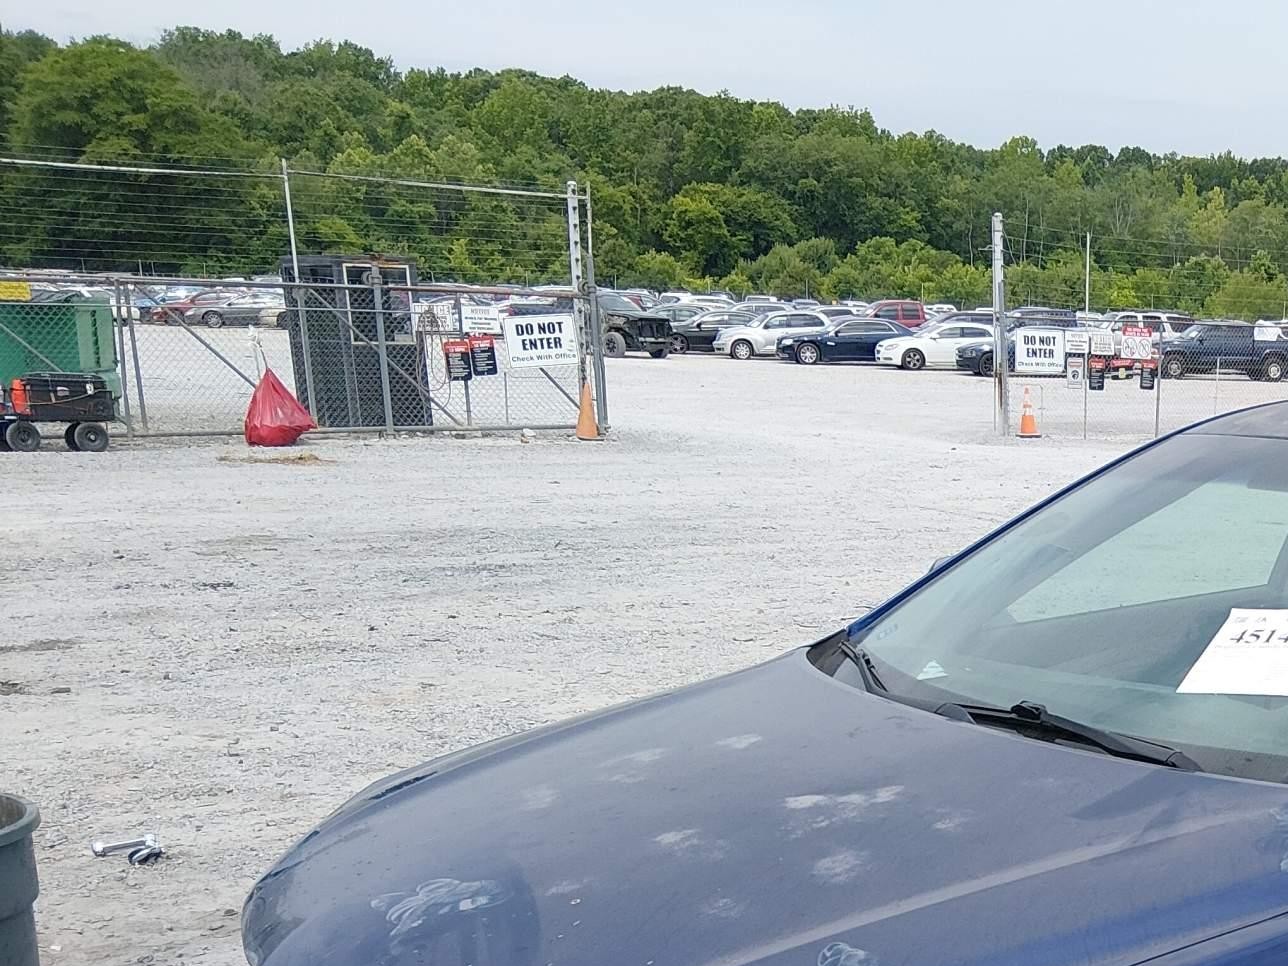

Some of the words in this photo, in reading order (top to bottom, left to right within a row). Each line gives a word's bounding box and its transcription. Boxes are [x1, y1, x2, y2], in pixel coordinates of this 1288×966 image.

[515, 323, 534, 336] DO
[537, 321, 564, 335] NOT
[521, 336, 563, 351] ENTER
[1023, 335, 1036, 346] DO
[1038, 336, 1057, 347] NOT
[554, 352, 577, 360] Office
[1026, 348, 1055, 359] ENTER
